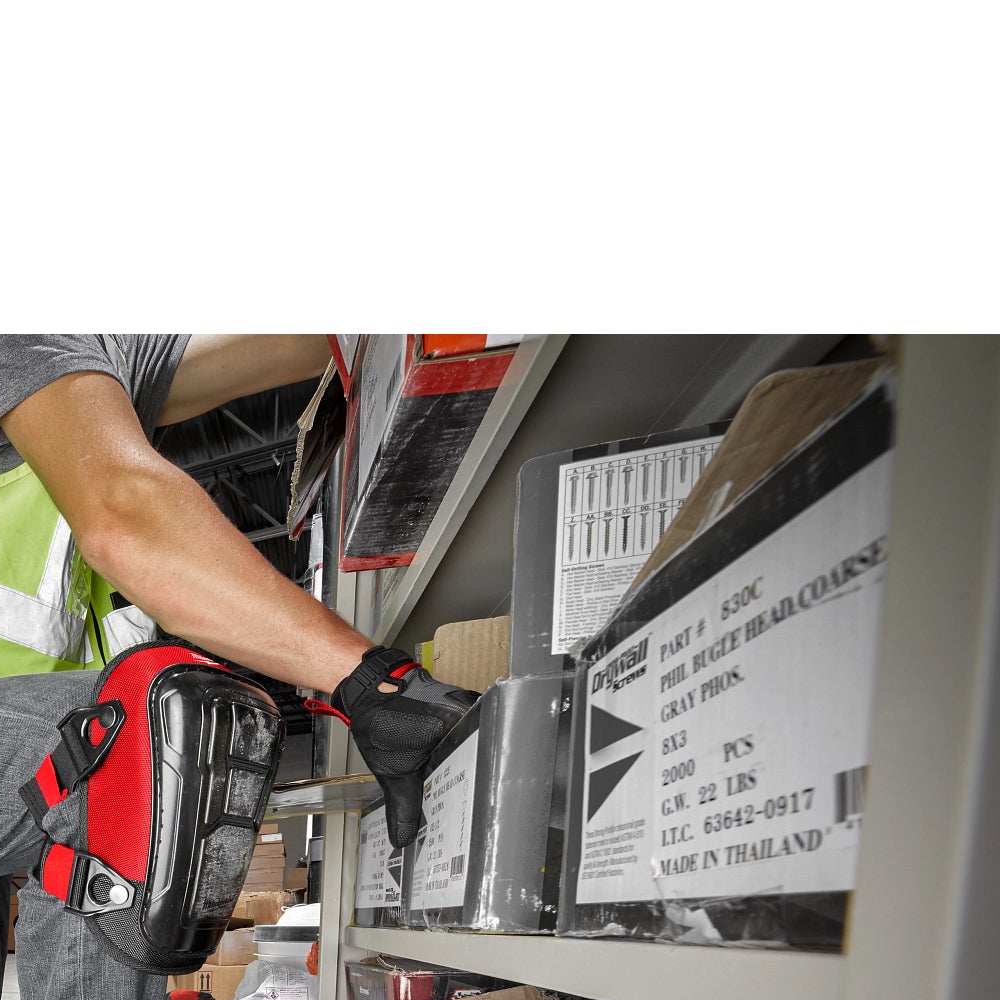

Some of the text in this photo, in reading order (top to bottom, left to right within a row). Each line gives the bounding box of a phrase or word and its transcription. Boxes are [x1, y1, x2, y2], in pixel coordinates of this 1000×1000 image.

[660, 625, 693, 664] PART
[720, 575, 765, 621] 830C
[591, 636, 649, 695] Drywall
[660, 662, 690, 694] PHIL
[692, 627, 742, 676] BUGLE
[660, 665, 745, 724] GRAY PHOS.
[661, 729, 687, 756] 8X3
[661, 733, 755, 787] 2000 PCS
[661, 768, 758, 817] G.W. 22 LBS
[703, 786, 816, 835] 63642-0917
[660, 828, 824, 877] MADE IN THAILAND
